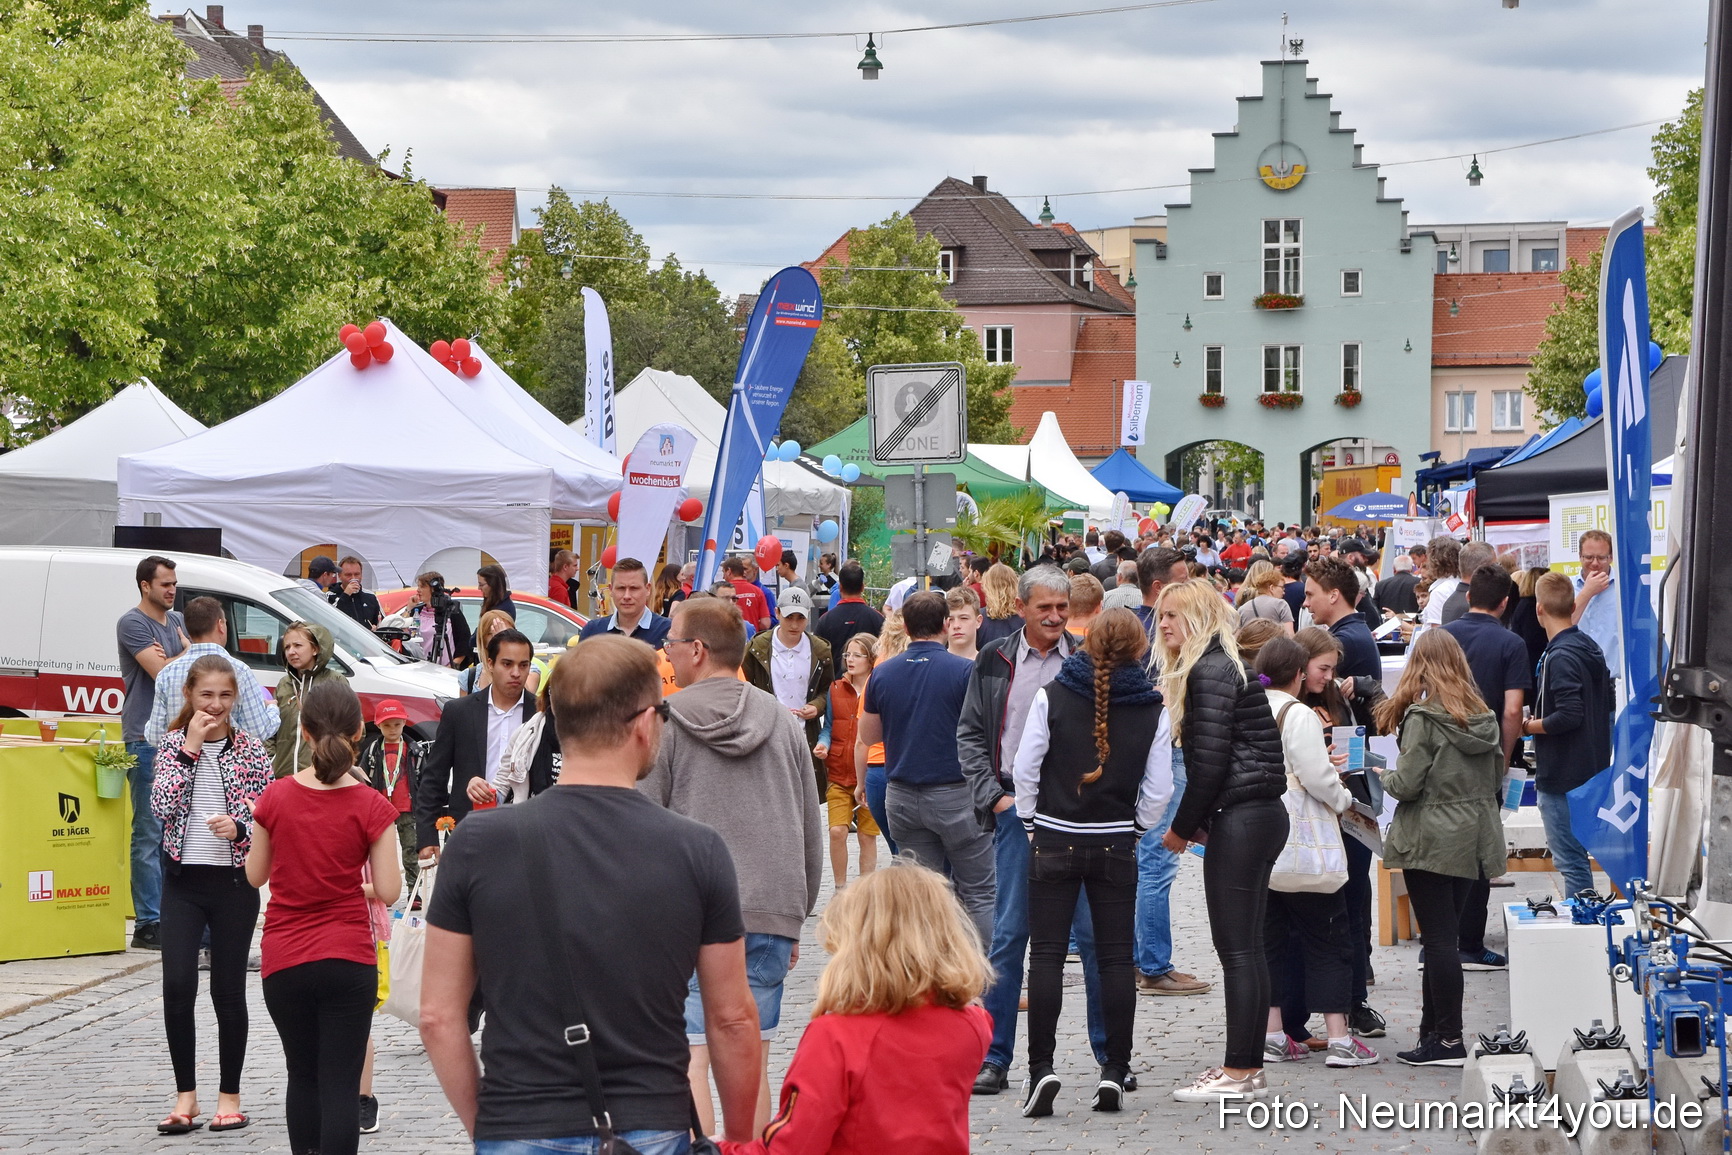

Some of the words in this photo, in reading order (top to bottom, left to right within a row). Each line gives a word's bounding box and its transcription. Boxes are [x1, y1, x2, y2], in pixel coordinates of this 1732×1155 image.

[770, 385, 784, 393] Energie
[1130, 384, 1143, 432] Silberhorn
[0, 656, 72, 671] Wochenzeitung
[75, 661, 84, 669] in
[52, 828, 65, 837] DIE
[67, 825, 90, 837] JÄGER
[56, 888, 82, 898] MAX
